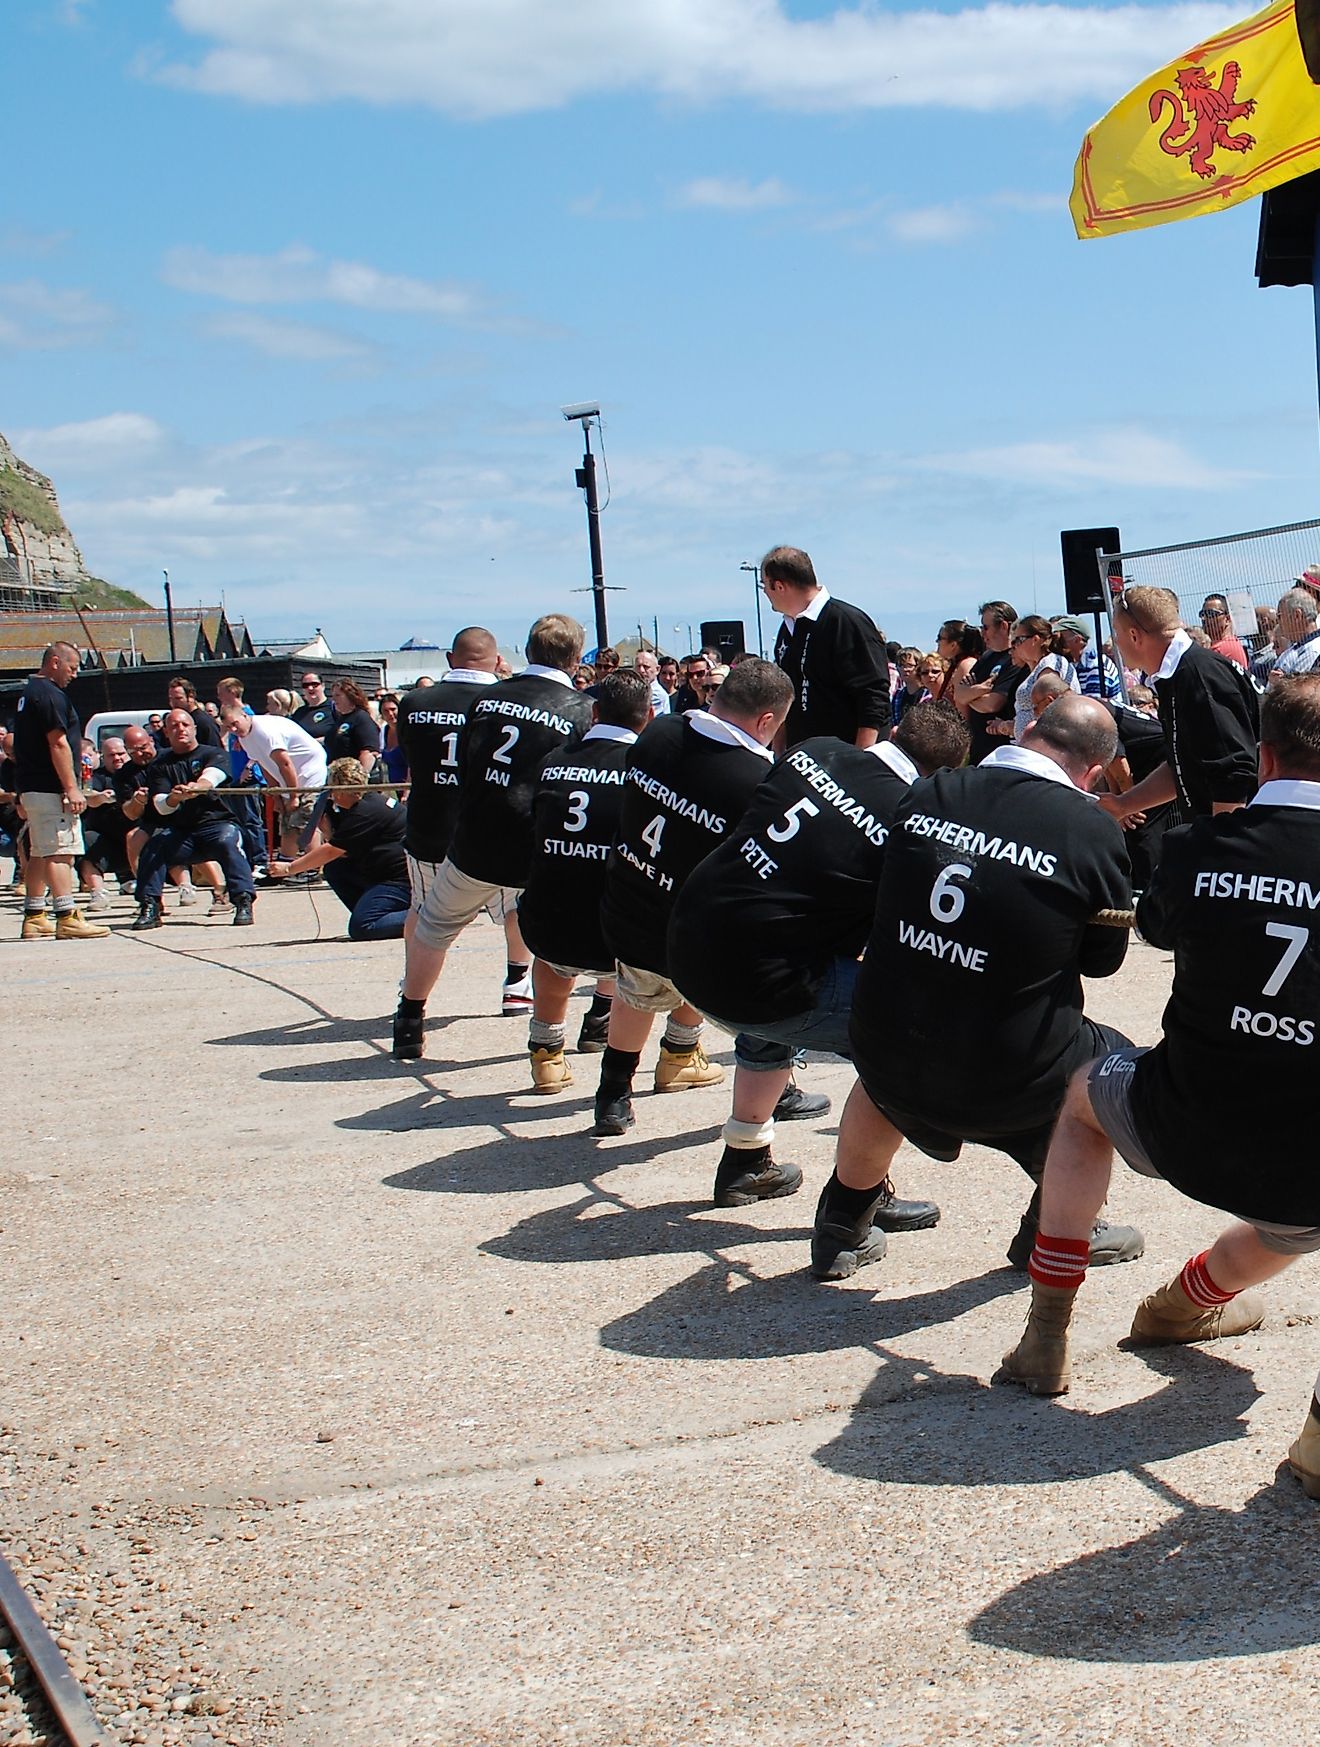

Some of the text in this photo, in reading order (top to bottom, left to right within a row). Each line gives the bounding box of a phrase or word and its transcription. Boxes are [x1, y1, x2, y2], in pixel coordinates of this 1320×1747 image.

[475, 699, 574, 736] FISHERMANS
[440, 732, 459, 767] 1
[492, 724, 520, 765] 2
[484, 767, 511, 787] IAN
[786, 750, 890, 847] FISHERMANS
[563, 790, 590, 832] 3
[625, 766, 727, 834] FISHERMANS
[766, 797, 821, 843] 5
[543, 838, 611, 861] STUART
[641, 814, 667, 859] 4
[739, 837, 779, 880] PETE
[904, 813, 1058, 877] FISHERMANS
[617, 842, 674, 892] DAVE H
[929, 863, 972, 924] 6
[898, 919, 989, 973] WAYNE
[1261, 921, 1309, 997] 7
[1230, 1005, 1316, 1046] ROSS
